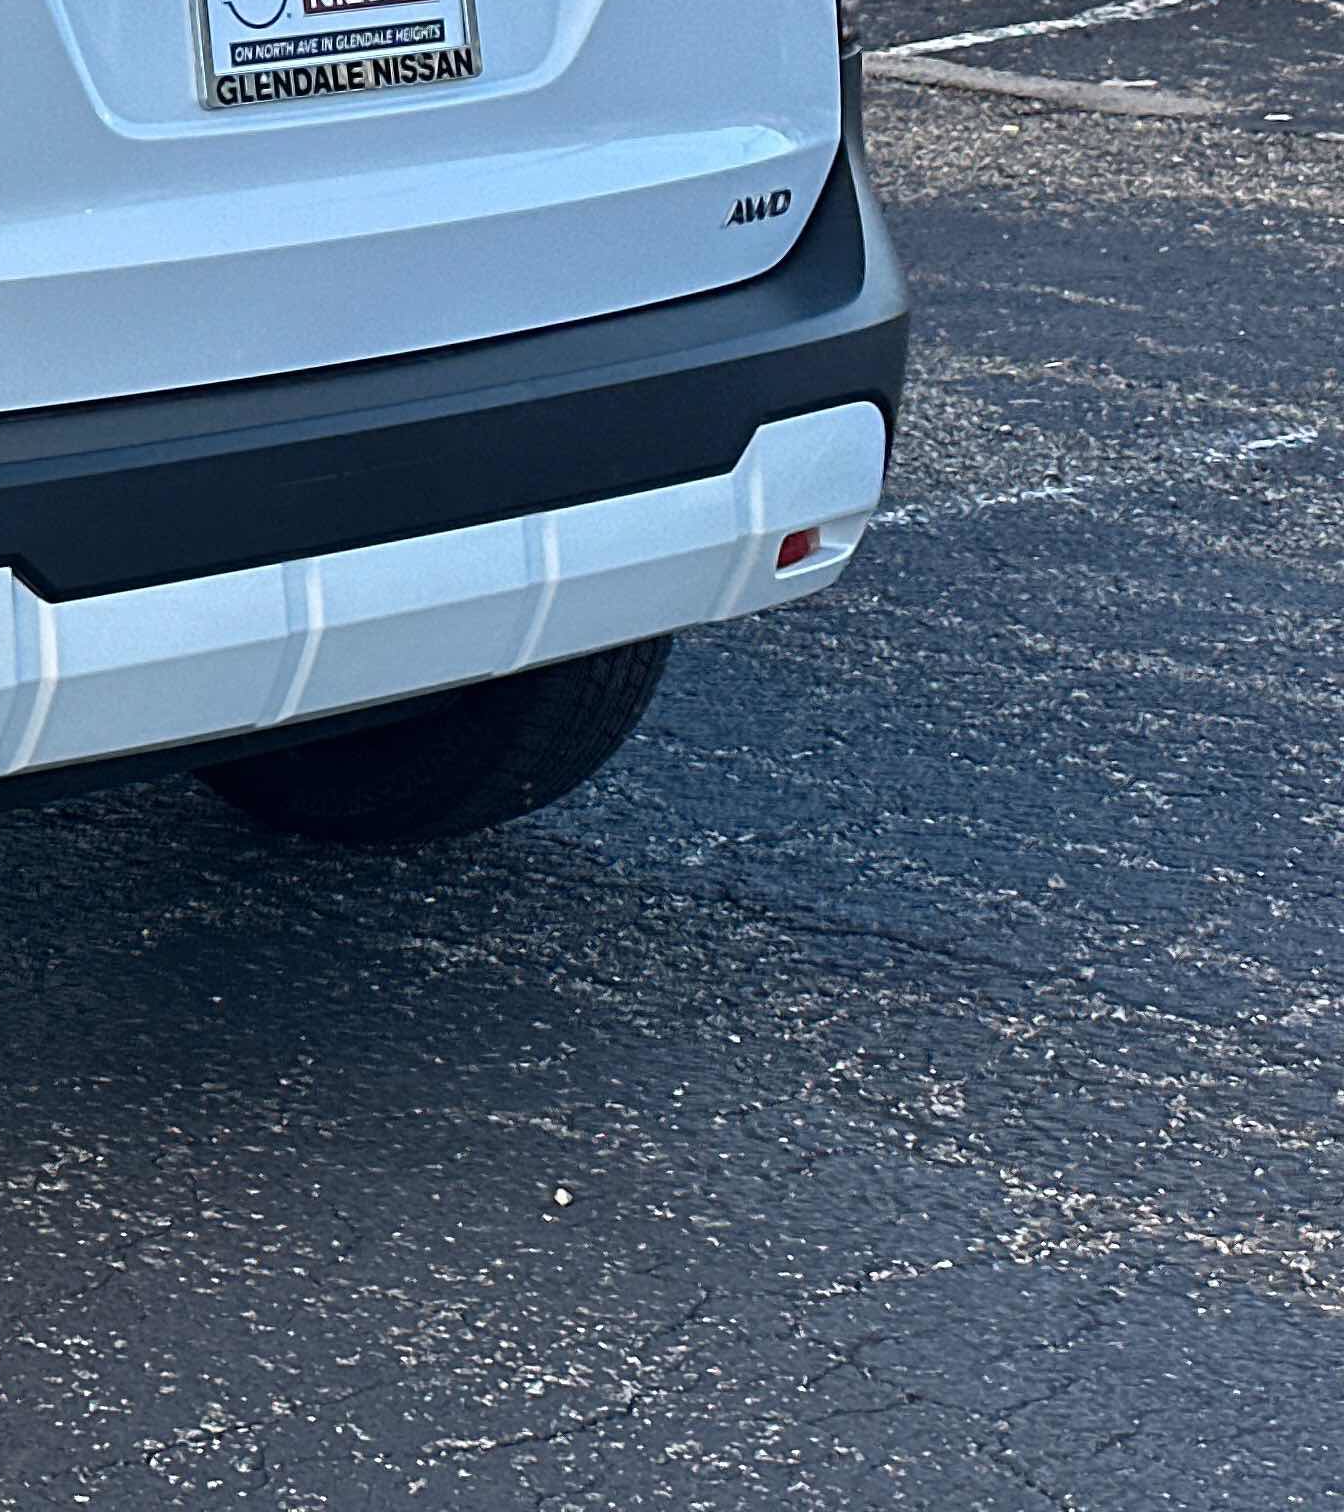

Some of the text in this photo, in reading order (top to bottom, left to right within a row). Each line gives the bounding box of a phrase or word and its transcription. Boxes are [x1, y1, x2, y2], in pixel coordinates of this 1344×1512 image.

[234, 24, 441, 63] ON NORTH AVE IN GLENDALE HEIGHTS
[216, 48, 475, 106] GLENDALE NISSAN
[720, 189, 791, 229] AWD
